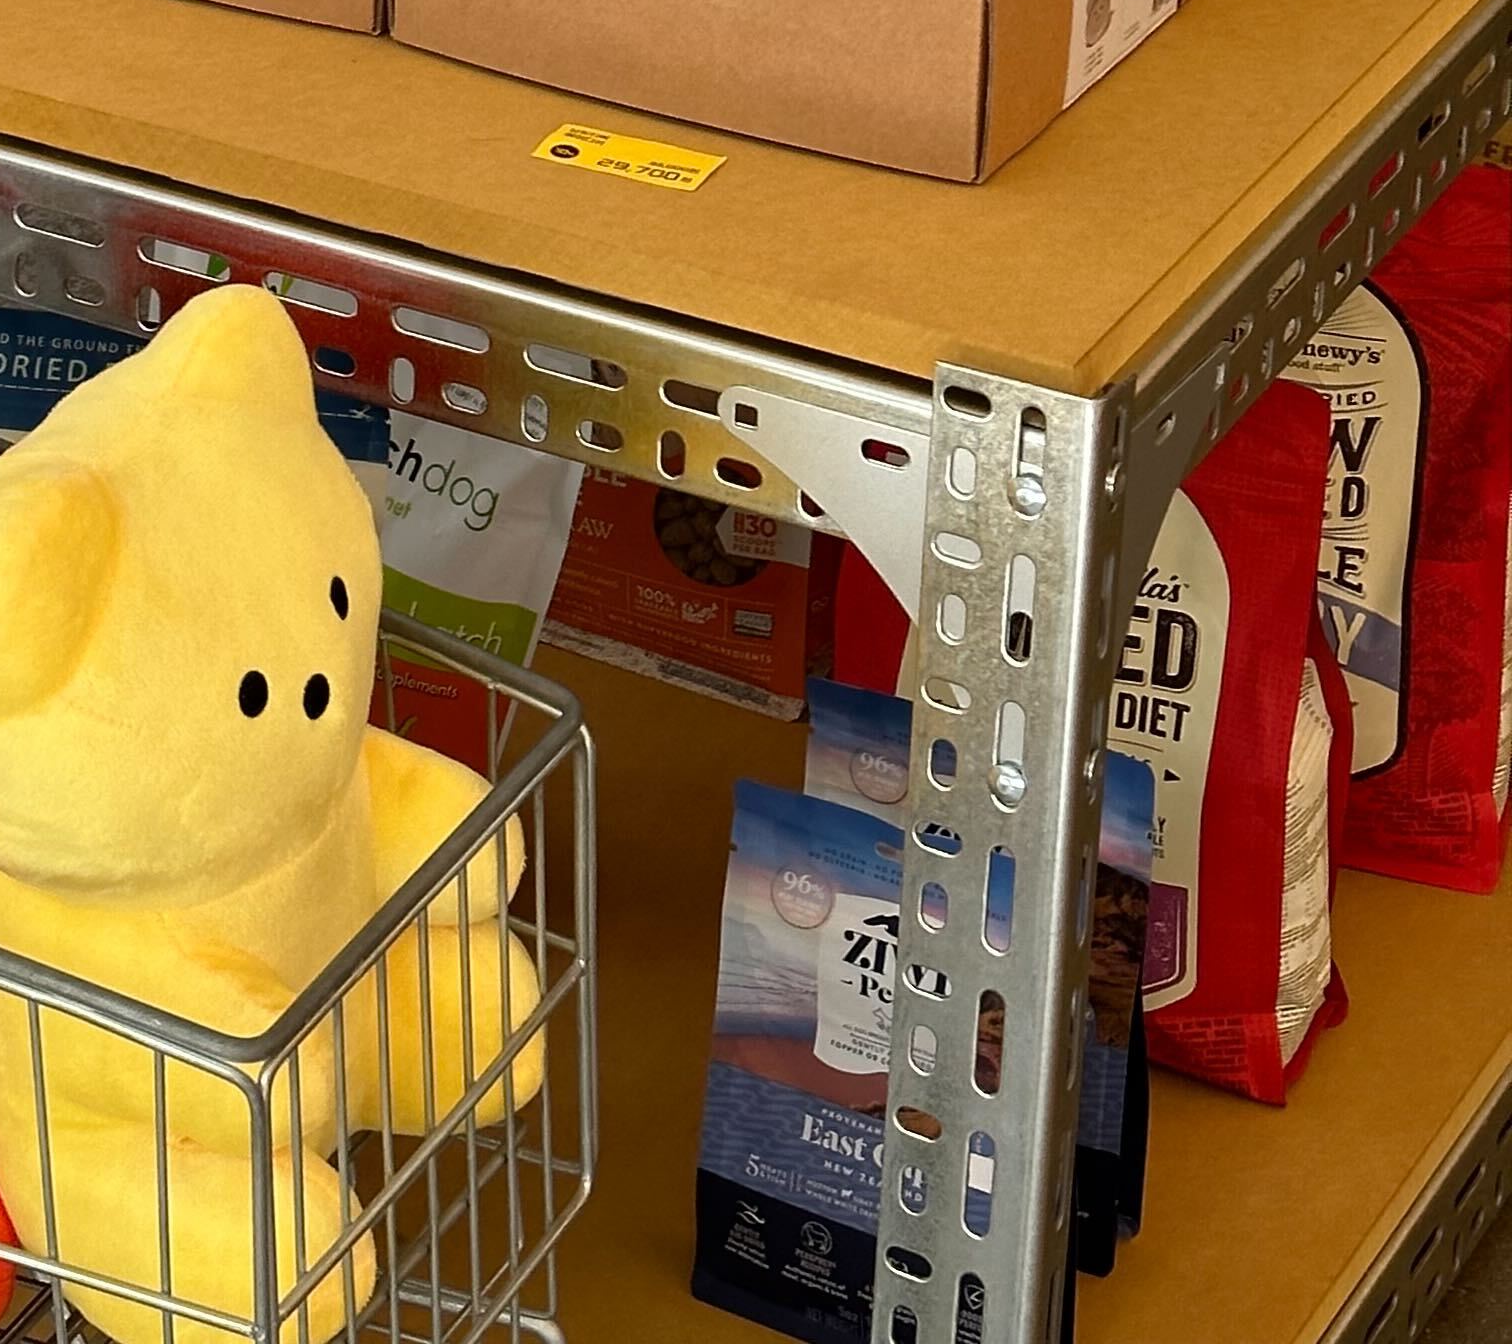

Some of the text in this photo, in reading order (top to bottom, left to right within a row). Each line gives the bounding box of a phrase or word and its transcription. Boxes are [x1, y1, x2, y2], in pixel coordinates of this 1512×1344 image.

[16, 333, 47, 349] THE
[51, 336, 120, 354] GROUND
[636, 585, 677, 607] 100%
[1114, 692, 1191, 742] DIET
[783, 871, 826, 900] 96%
[799, 1114, 869, 1162] East
[823, 1159, 854, 1176] NEW
